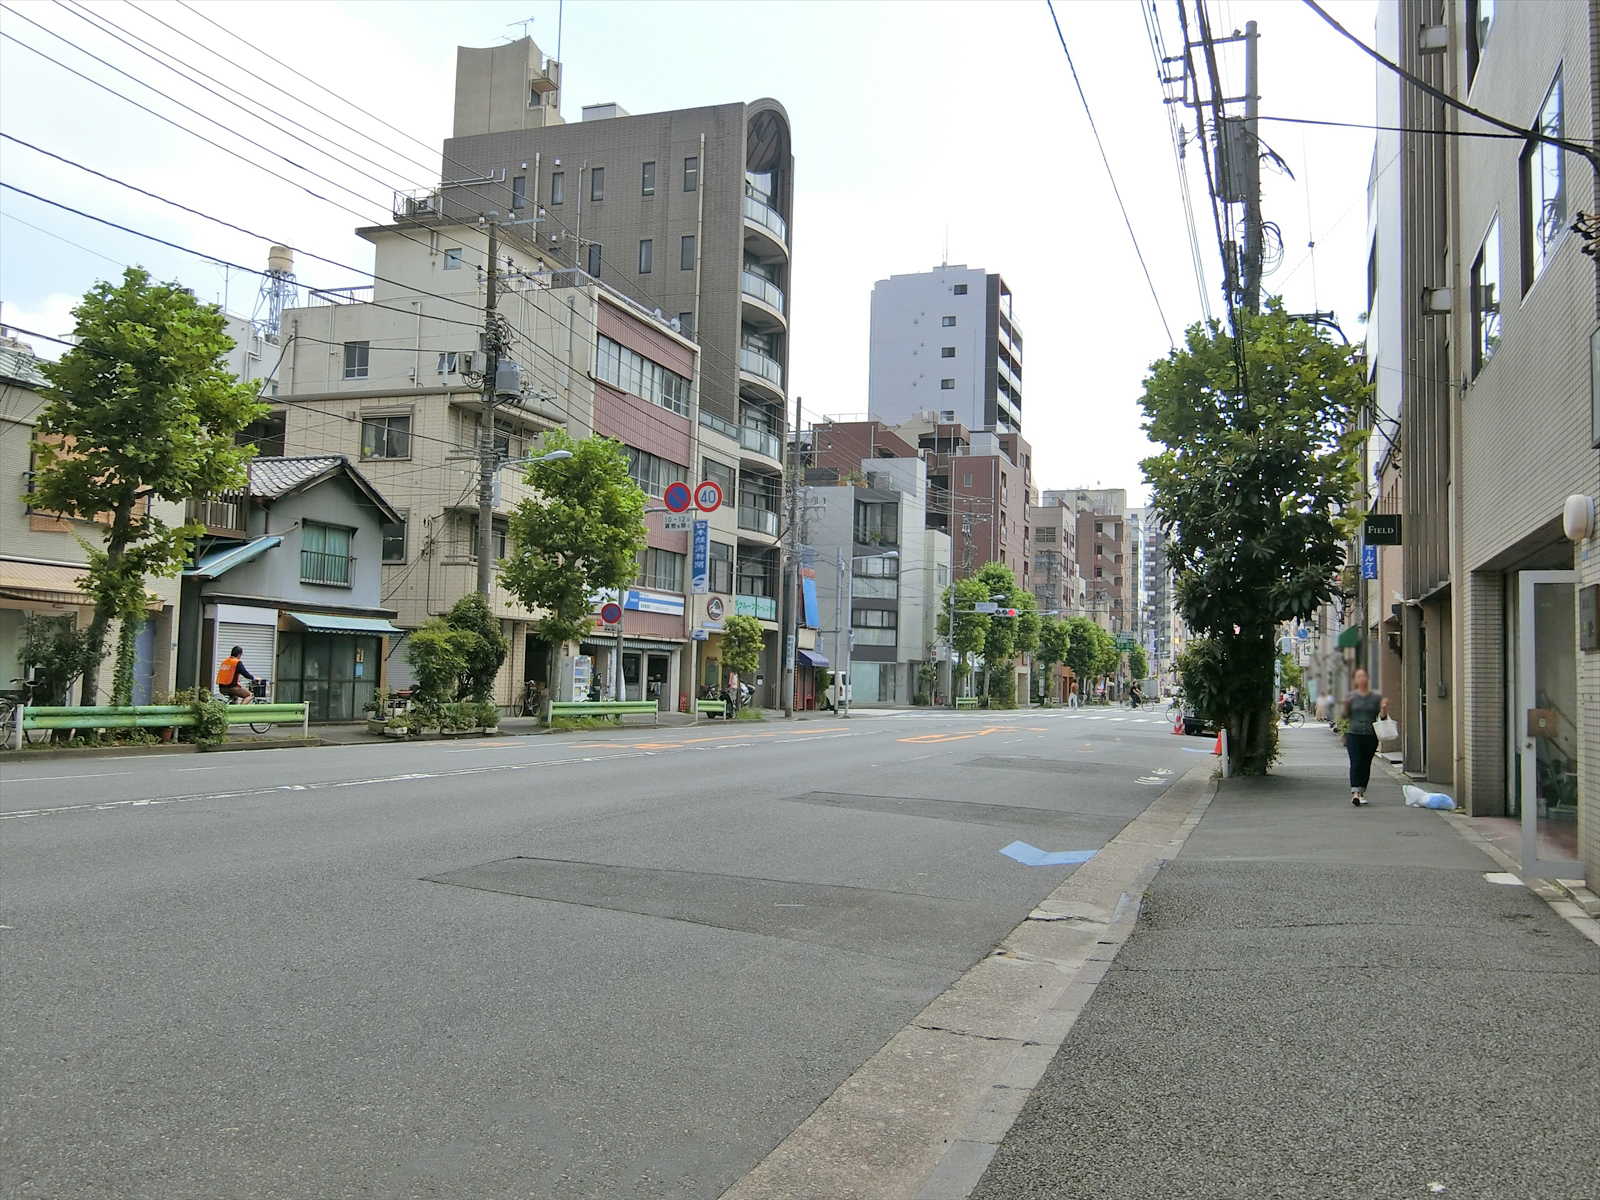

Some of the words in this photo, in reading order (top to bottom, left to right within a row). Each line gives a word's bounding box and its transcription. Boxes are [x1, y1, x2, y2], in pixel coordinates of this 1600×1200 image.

[700, 490, 716, 504] 40
[1368, 526, 1394, 534] FIELD
[694, 522, 707, 569] 日本経済新聞
